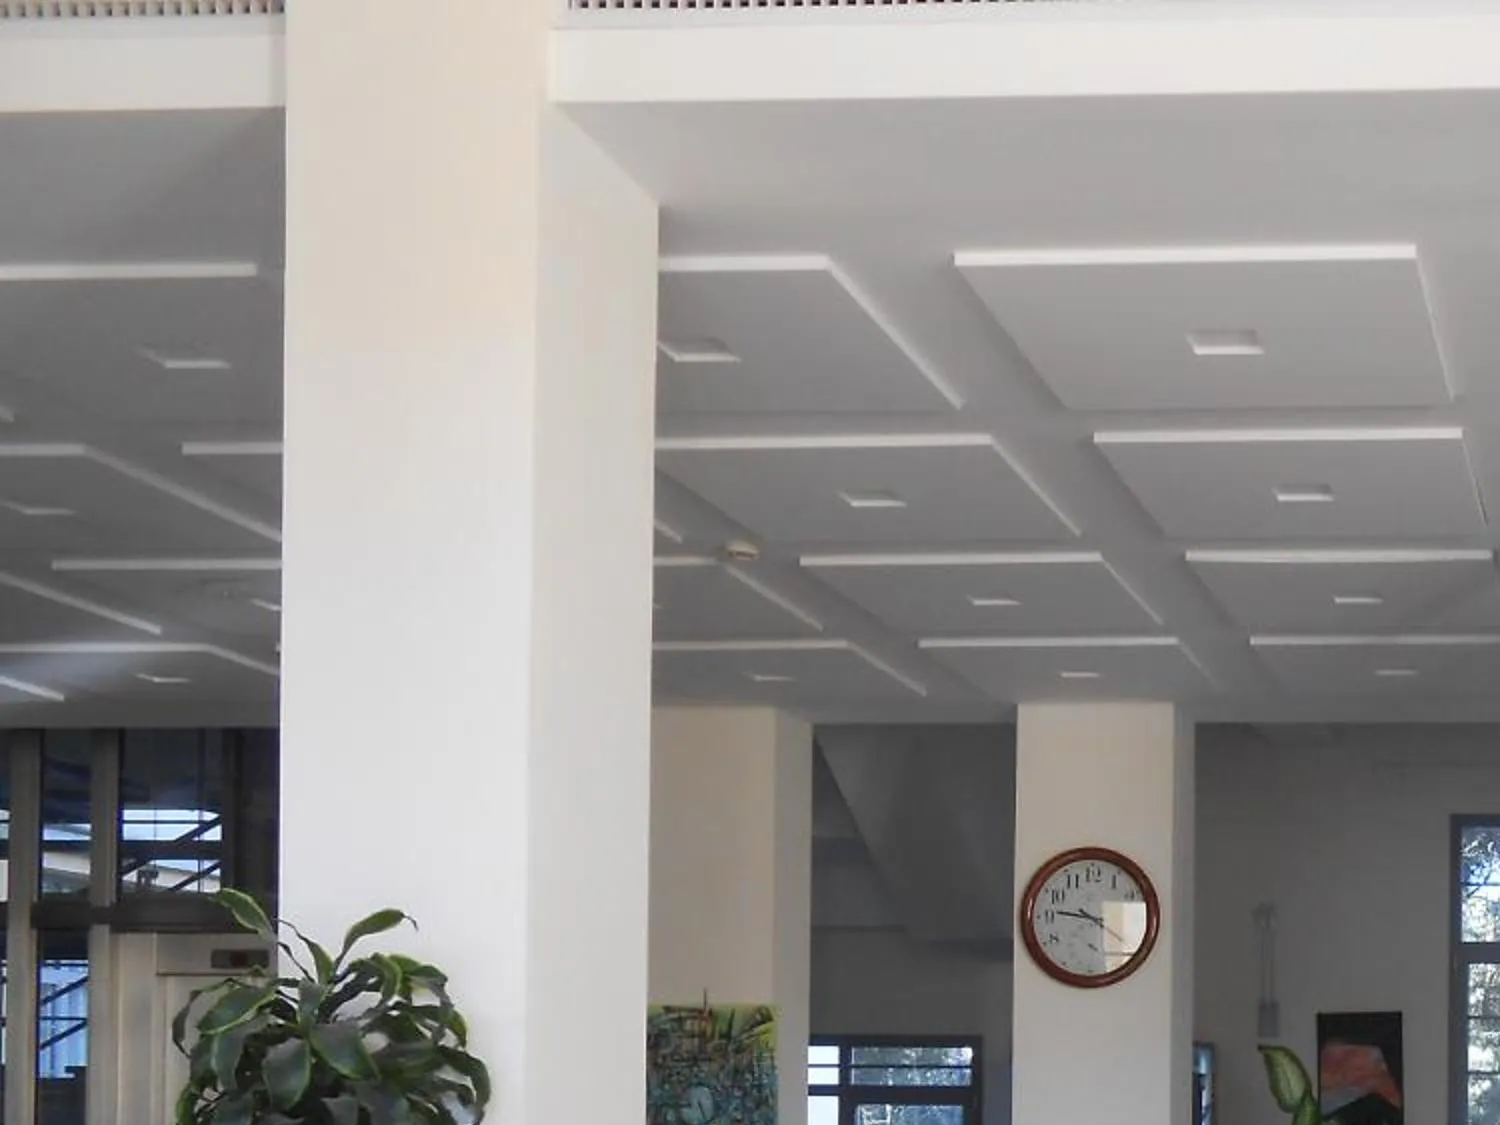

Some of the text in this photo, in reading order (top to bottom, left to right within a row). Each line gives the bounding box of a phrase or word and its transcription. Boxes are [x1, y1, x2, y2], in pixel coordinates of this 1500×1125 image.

[1067, 874, 1080, 889] 11
[1086, 867, 1102, 883] 12
[1051, 889, 1065, 904] 10
[1045, 910, 1055, 925] 9
